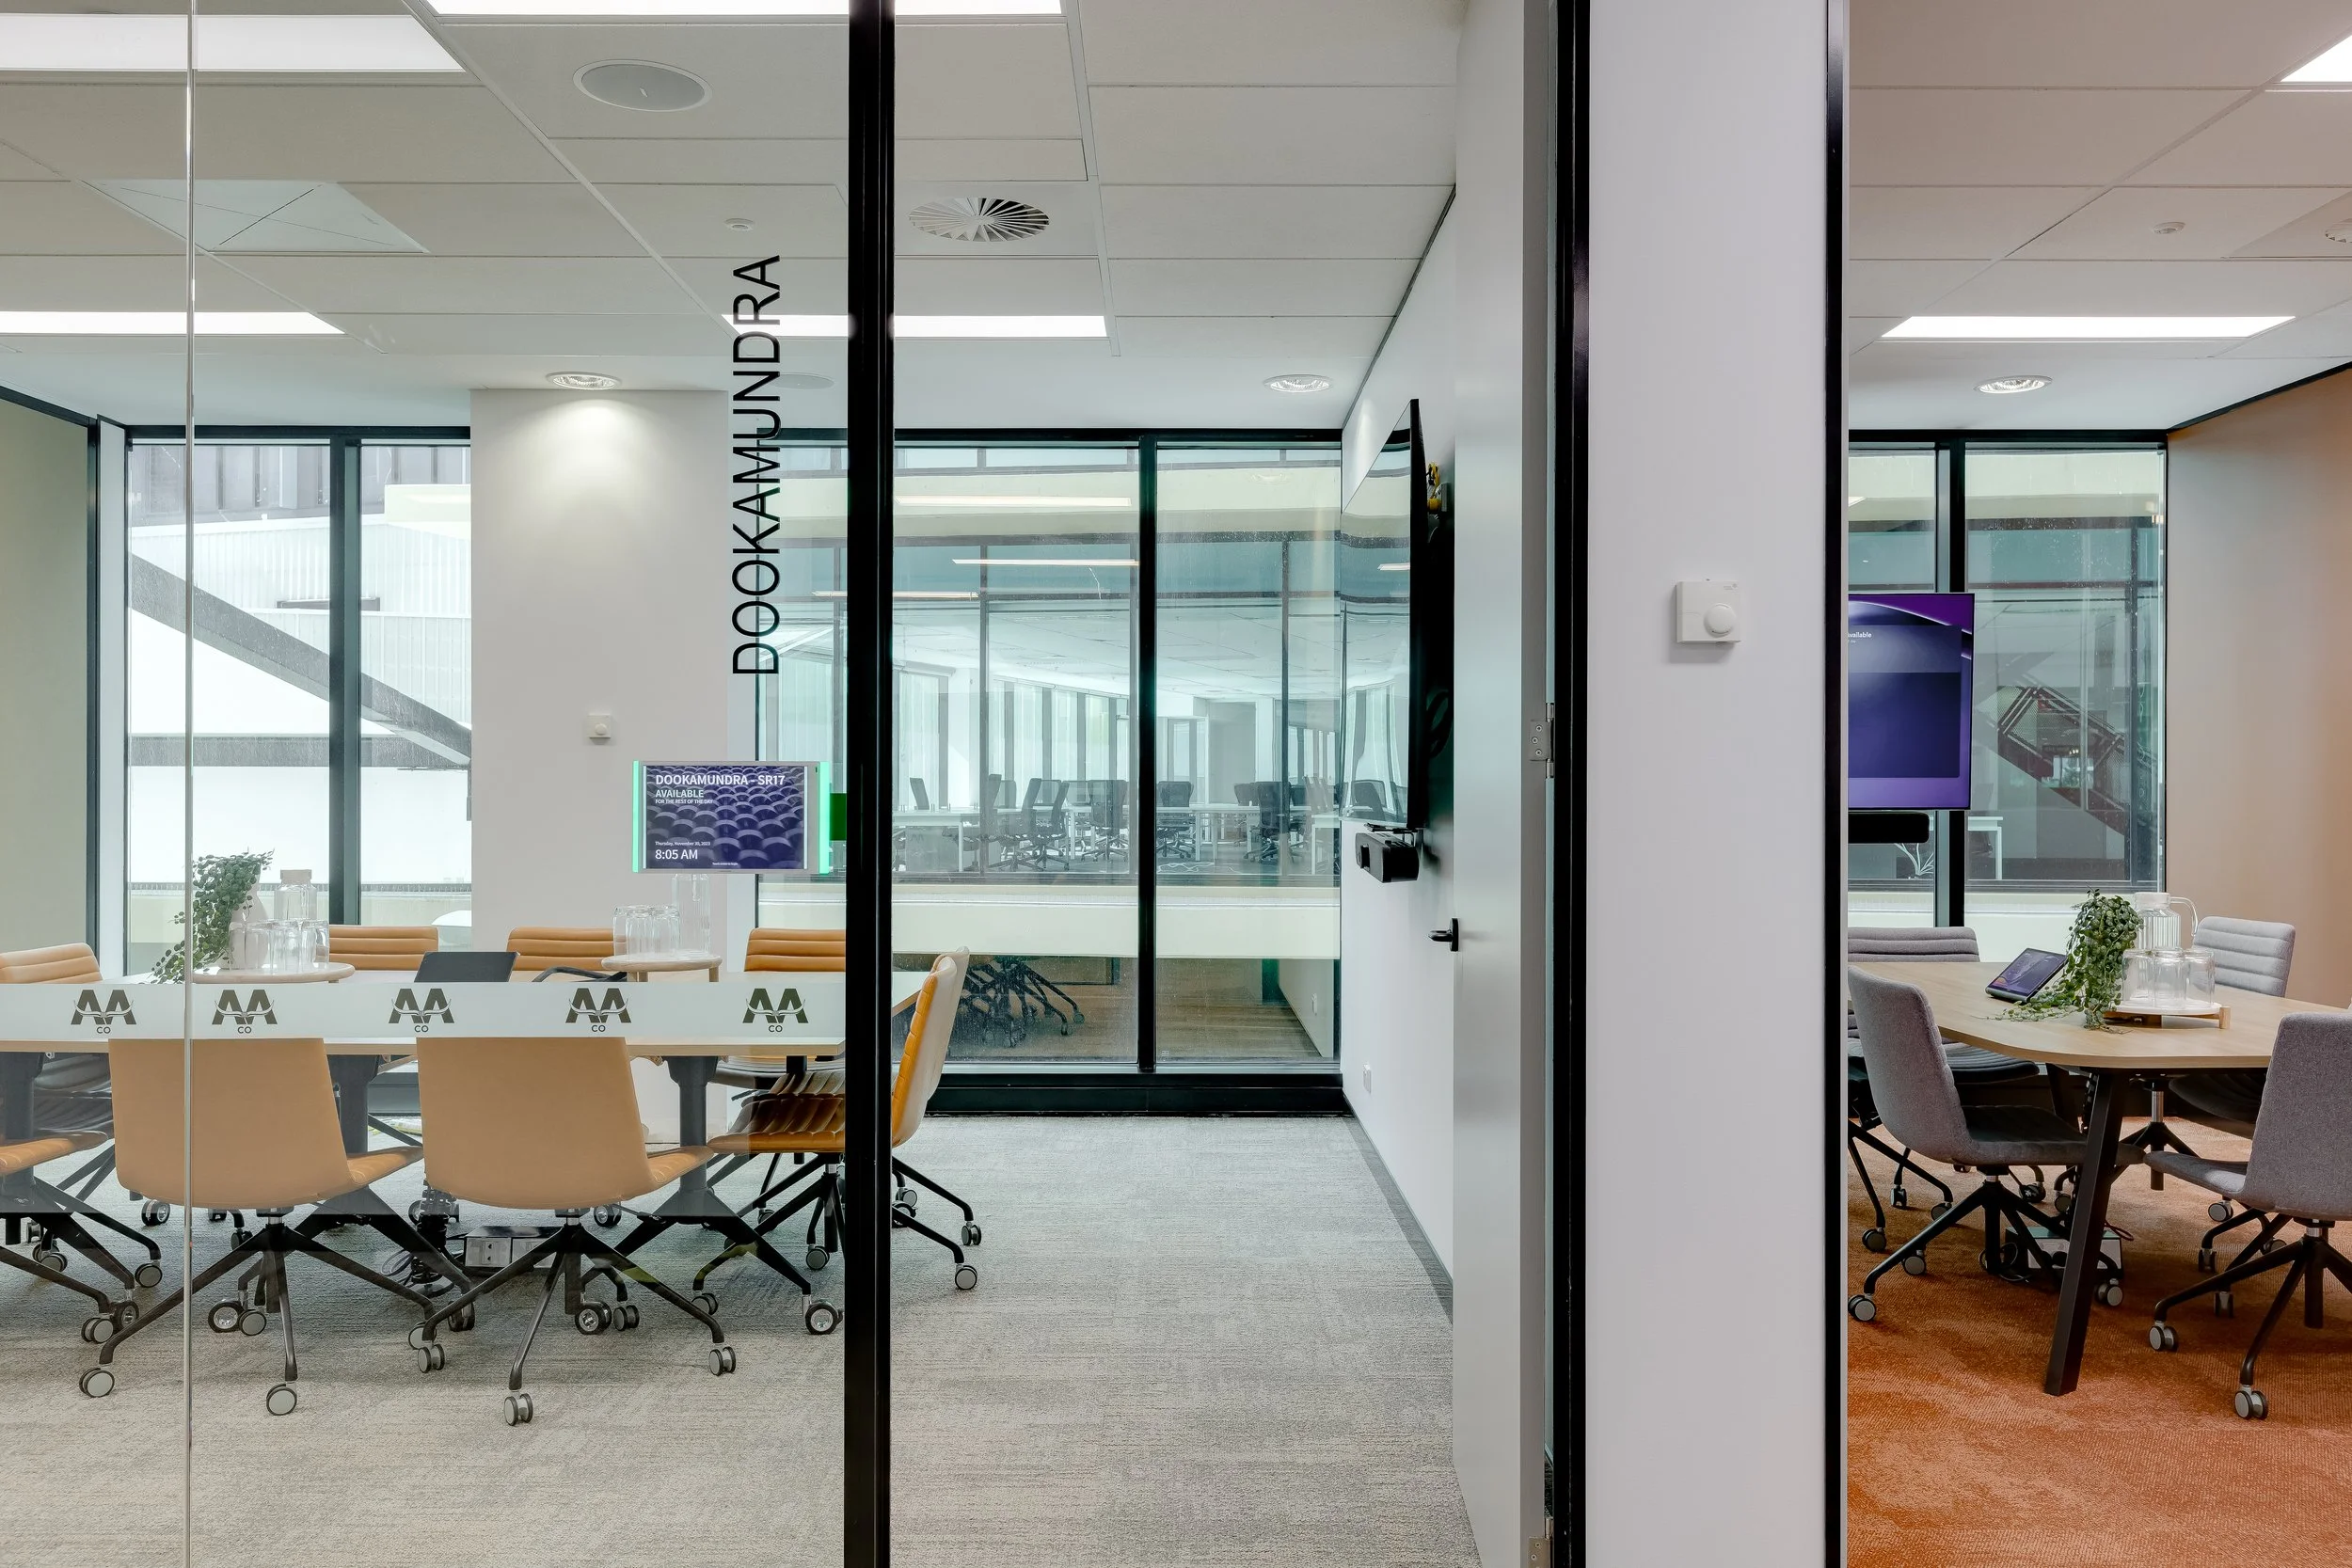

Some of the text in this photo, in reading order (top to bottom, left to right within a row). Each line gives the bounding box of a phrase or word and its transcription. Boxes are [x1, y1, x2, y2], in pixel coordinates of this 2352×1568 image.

[731, 255, 781, 674] DOOKAMUNDRA
[656, 774, 748, 785] DOOKAMUNDRA
[757, 774, 786, 785] SR17
[655, 789, 705, 798] AVAILABLE
[655, 848, 698, 860] 8:05 AM
